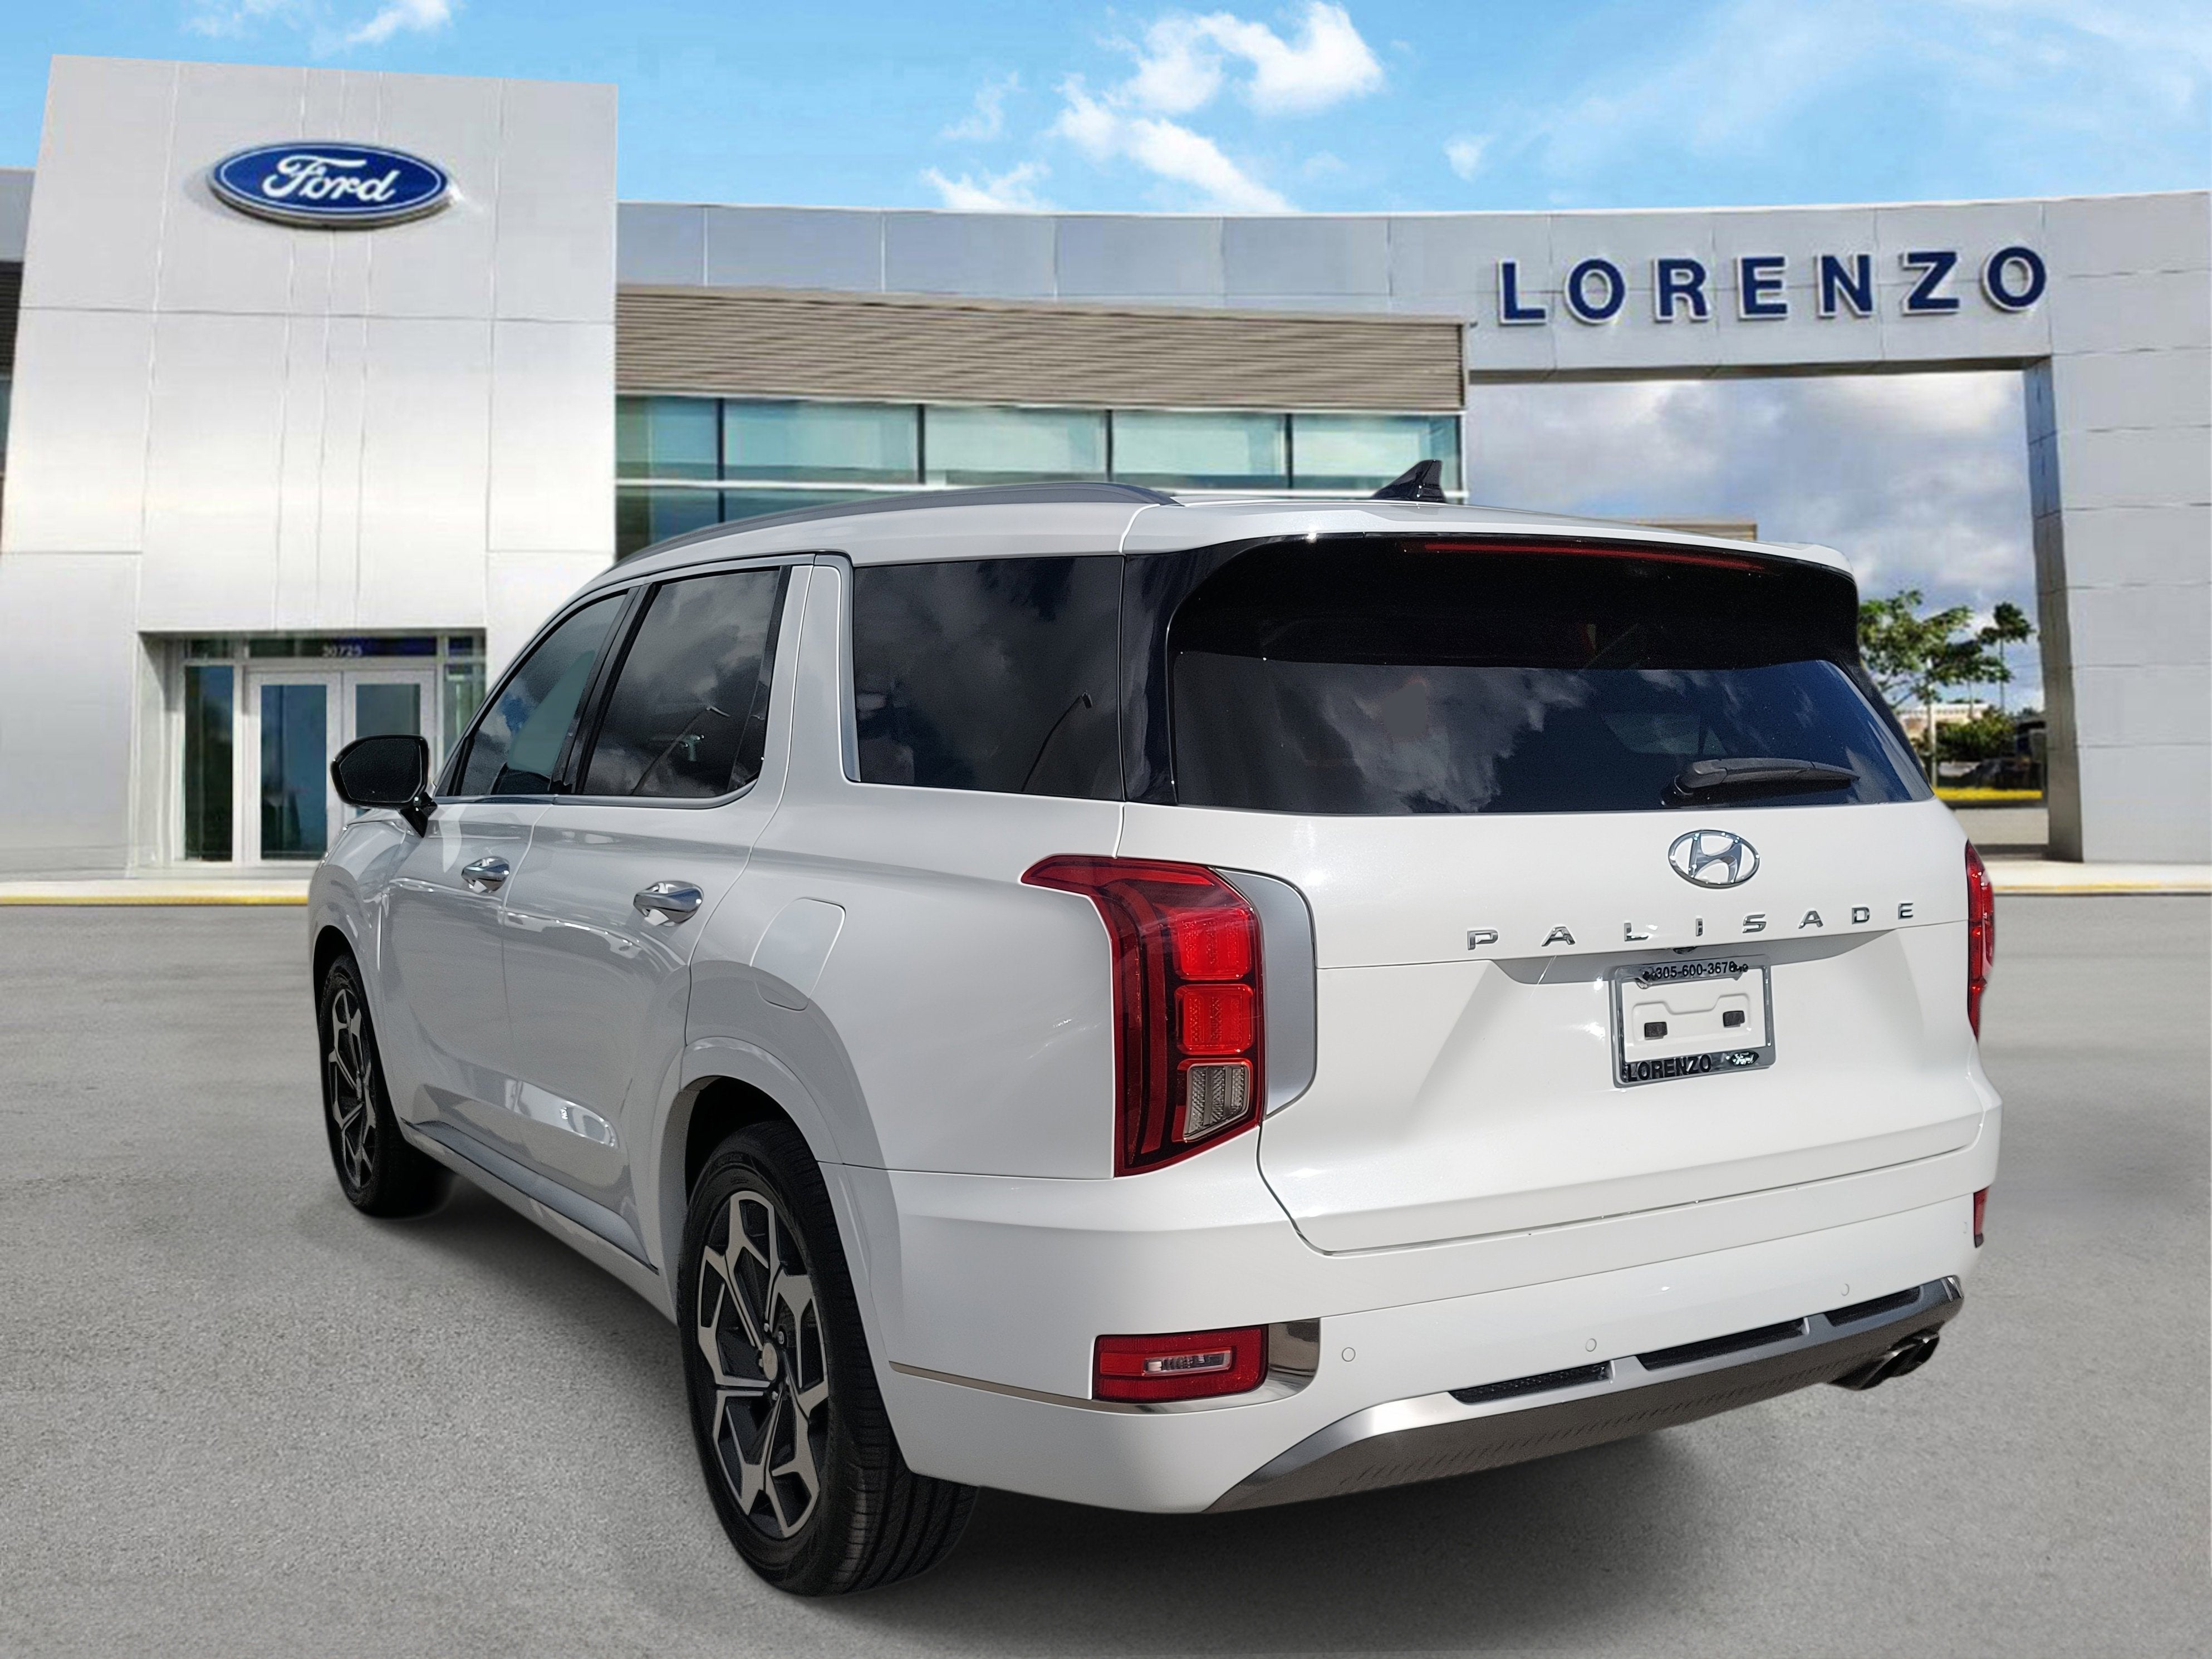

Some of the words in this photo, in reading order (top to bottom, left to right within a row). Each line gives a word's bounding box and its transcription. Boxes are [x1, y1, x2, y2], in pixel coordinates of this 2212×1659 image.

[263, 155, 399, 201] Ford
[1498, 245, 2048, 325] LORENZO
[1467, 902, 1915, 950] PALISADE
[1627, 1054, 1711, 1082] LORENZO
